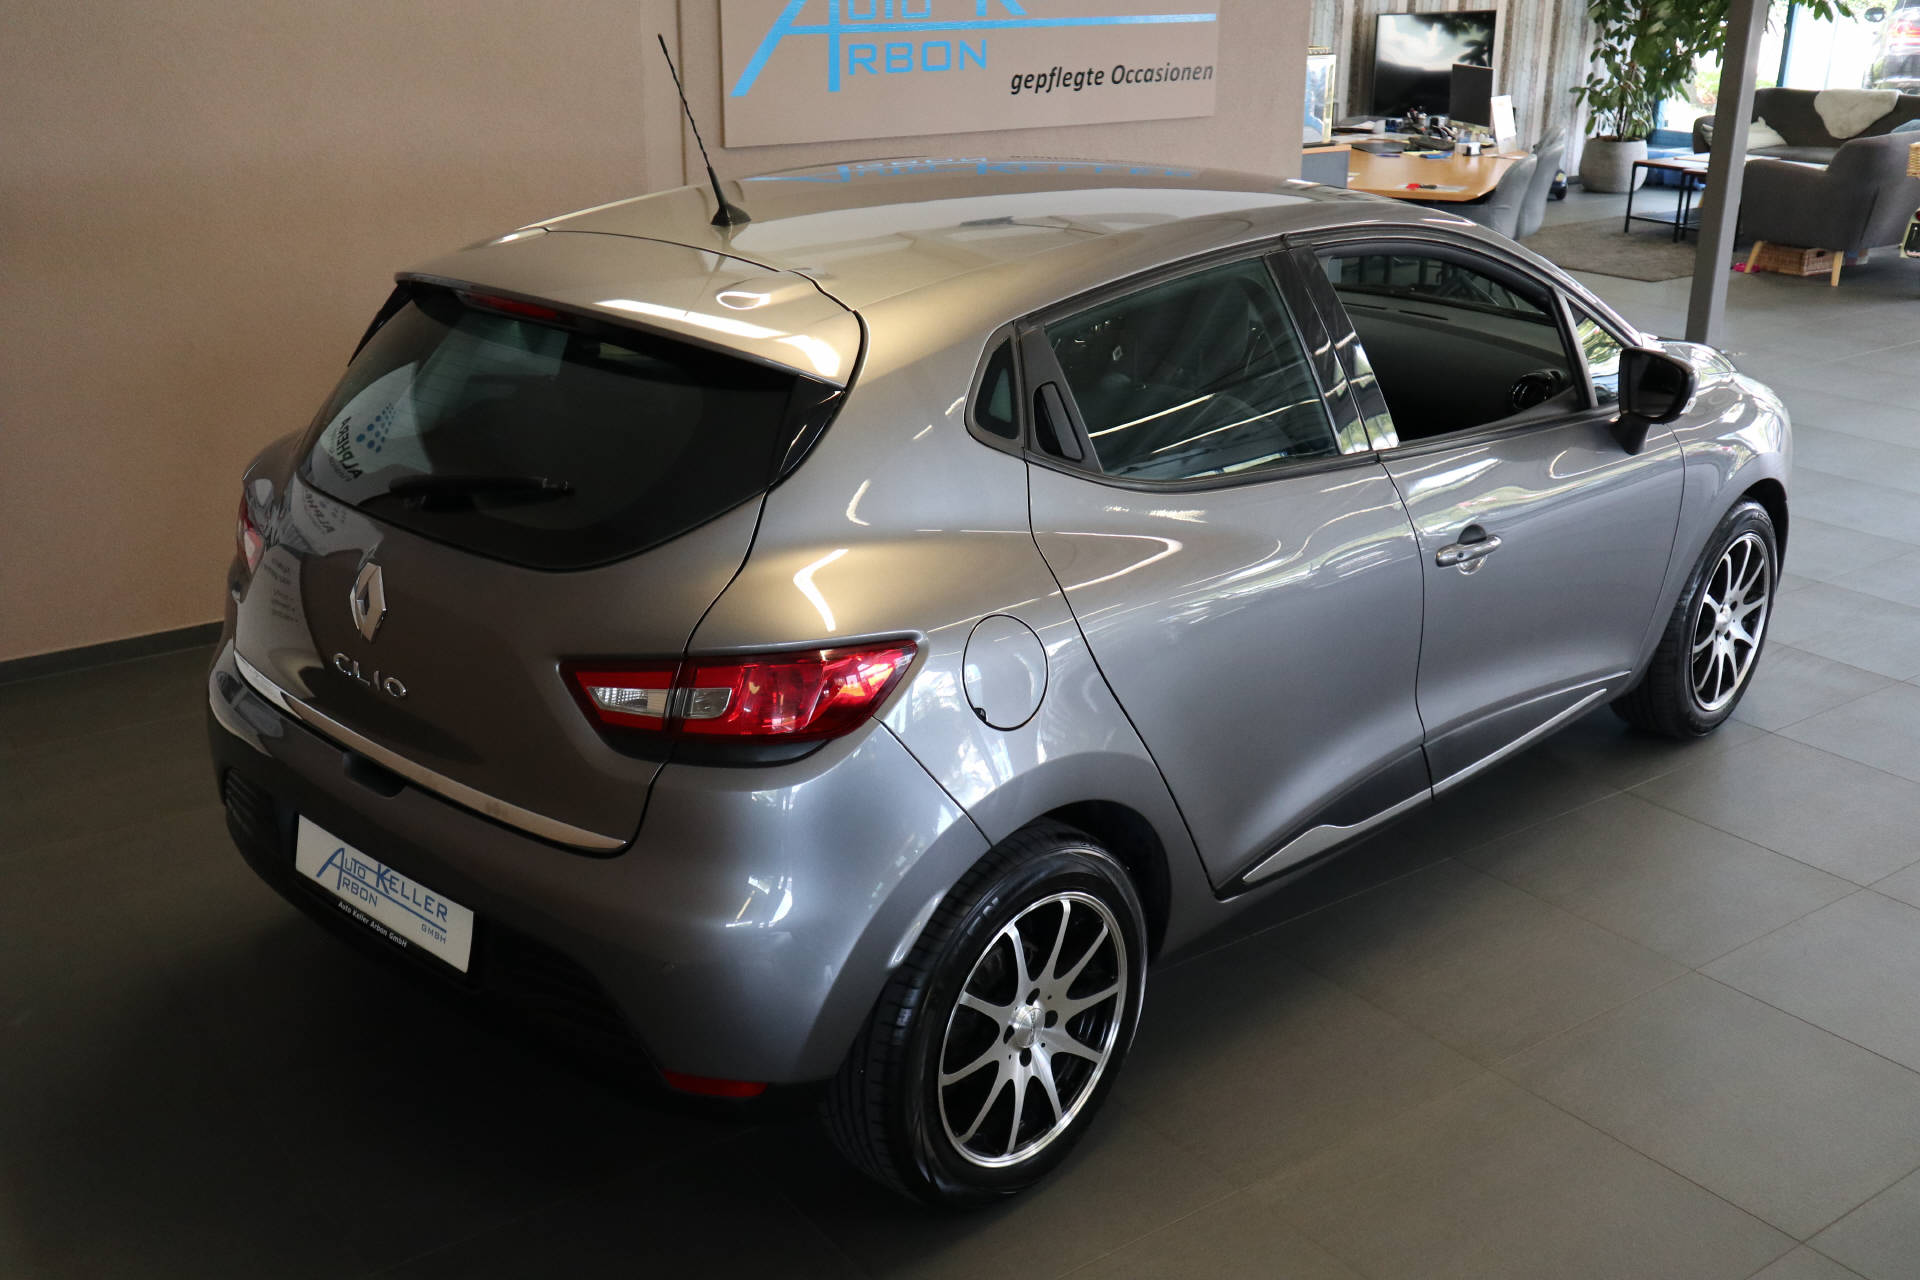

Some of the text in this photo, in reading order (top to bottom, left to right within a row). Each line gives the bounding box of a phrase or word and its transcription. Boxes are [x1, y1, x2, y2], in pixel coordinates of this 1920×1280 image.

[1011, 62, 1214, 94] gepflegte Occasionen
[333, 652, 407, 697] CLIO
[338, 901, 351, 914] Auto
[376, 863, 449, 923] KELLER
[421, 923, 448, 945] GMBH
